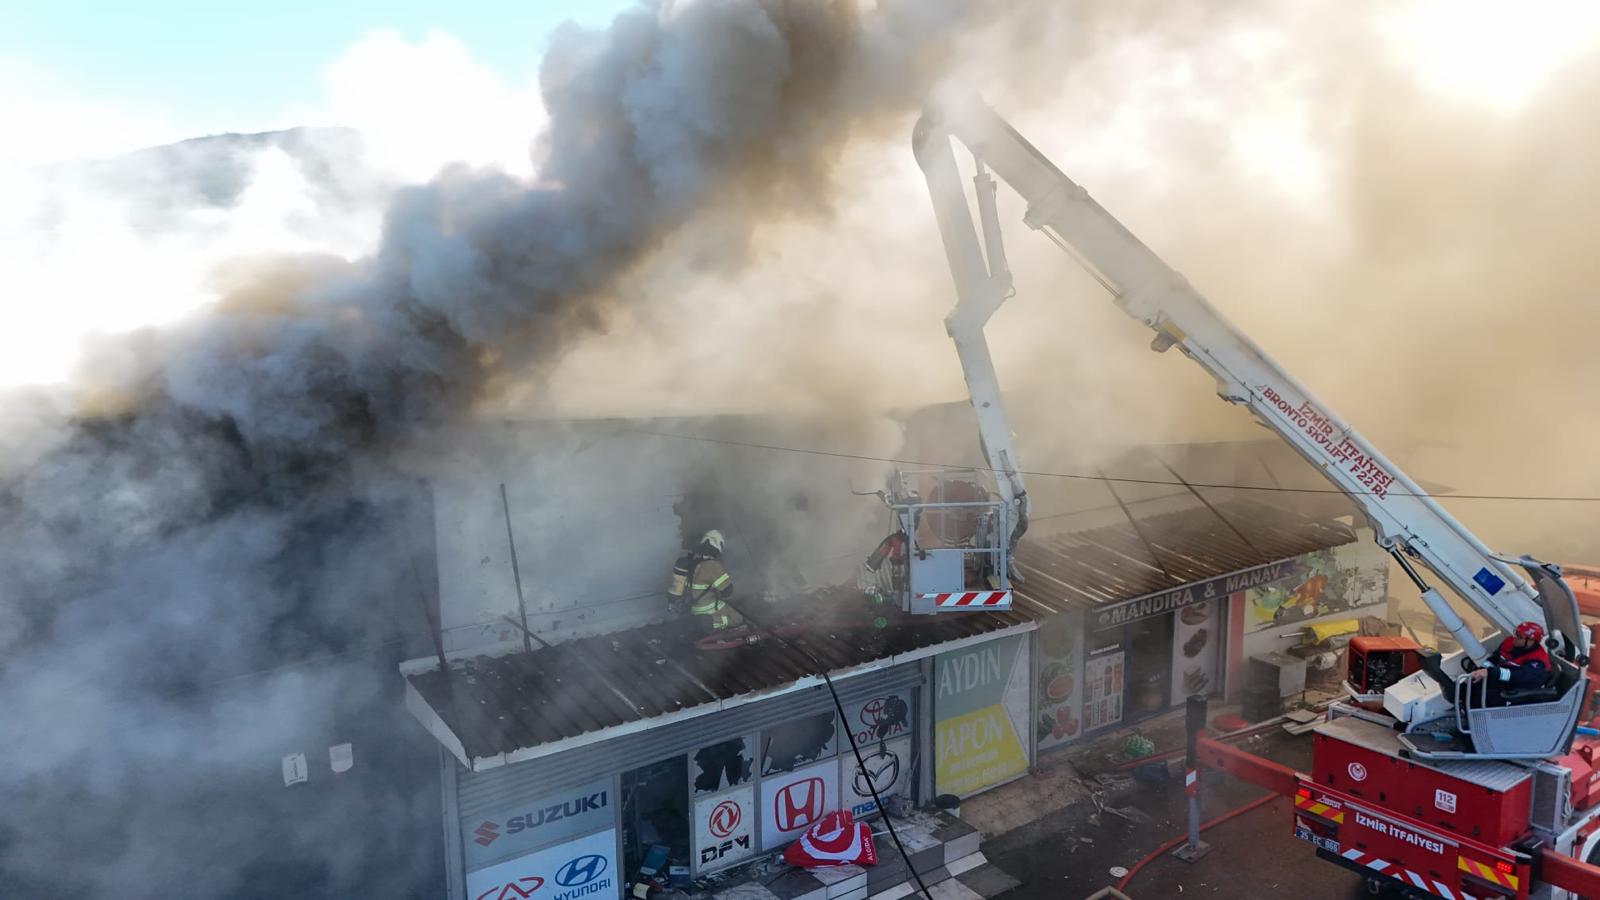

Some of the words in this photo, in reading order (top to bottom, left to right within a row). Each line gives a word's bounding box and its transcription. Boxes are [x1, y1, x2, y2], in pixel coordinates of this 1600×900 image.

[1262, 387, 1306, 428] BRONTO
[1305, 426, 1350, 464] SKYLIFT
[1298, 401, 1333, 437] İZMİR
[1338, 436, 1396, 489] İTFAİYESİ
[1111, 588, 1194, 623] MANDIRA
[1204, 582, 1216, 598] &
[1226, 564, 1281, 592] MANAV
[938, 644, 1001, 699] AYDIN
[937, 714, 1004, 769] JAPON
[506, 791, 607, 835] SUZUKI
[1439, 792, 1453, 804] 112
[701, 834, 750, 864] DFM
[1355, 812, 1387, 834] İZMİR
[1389, 826, 1444, 854] İTFAİYESİ
